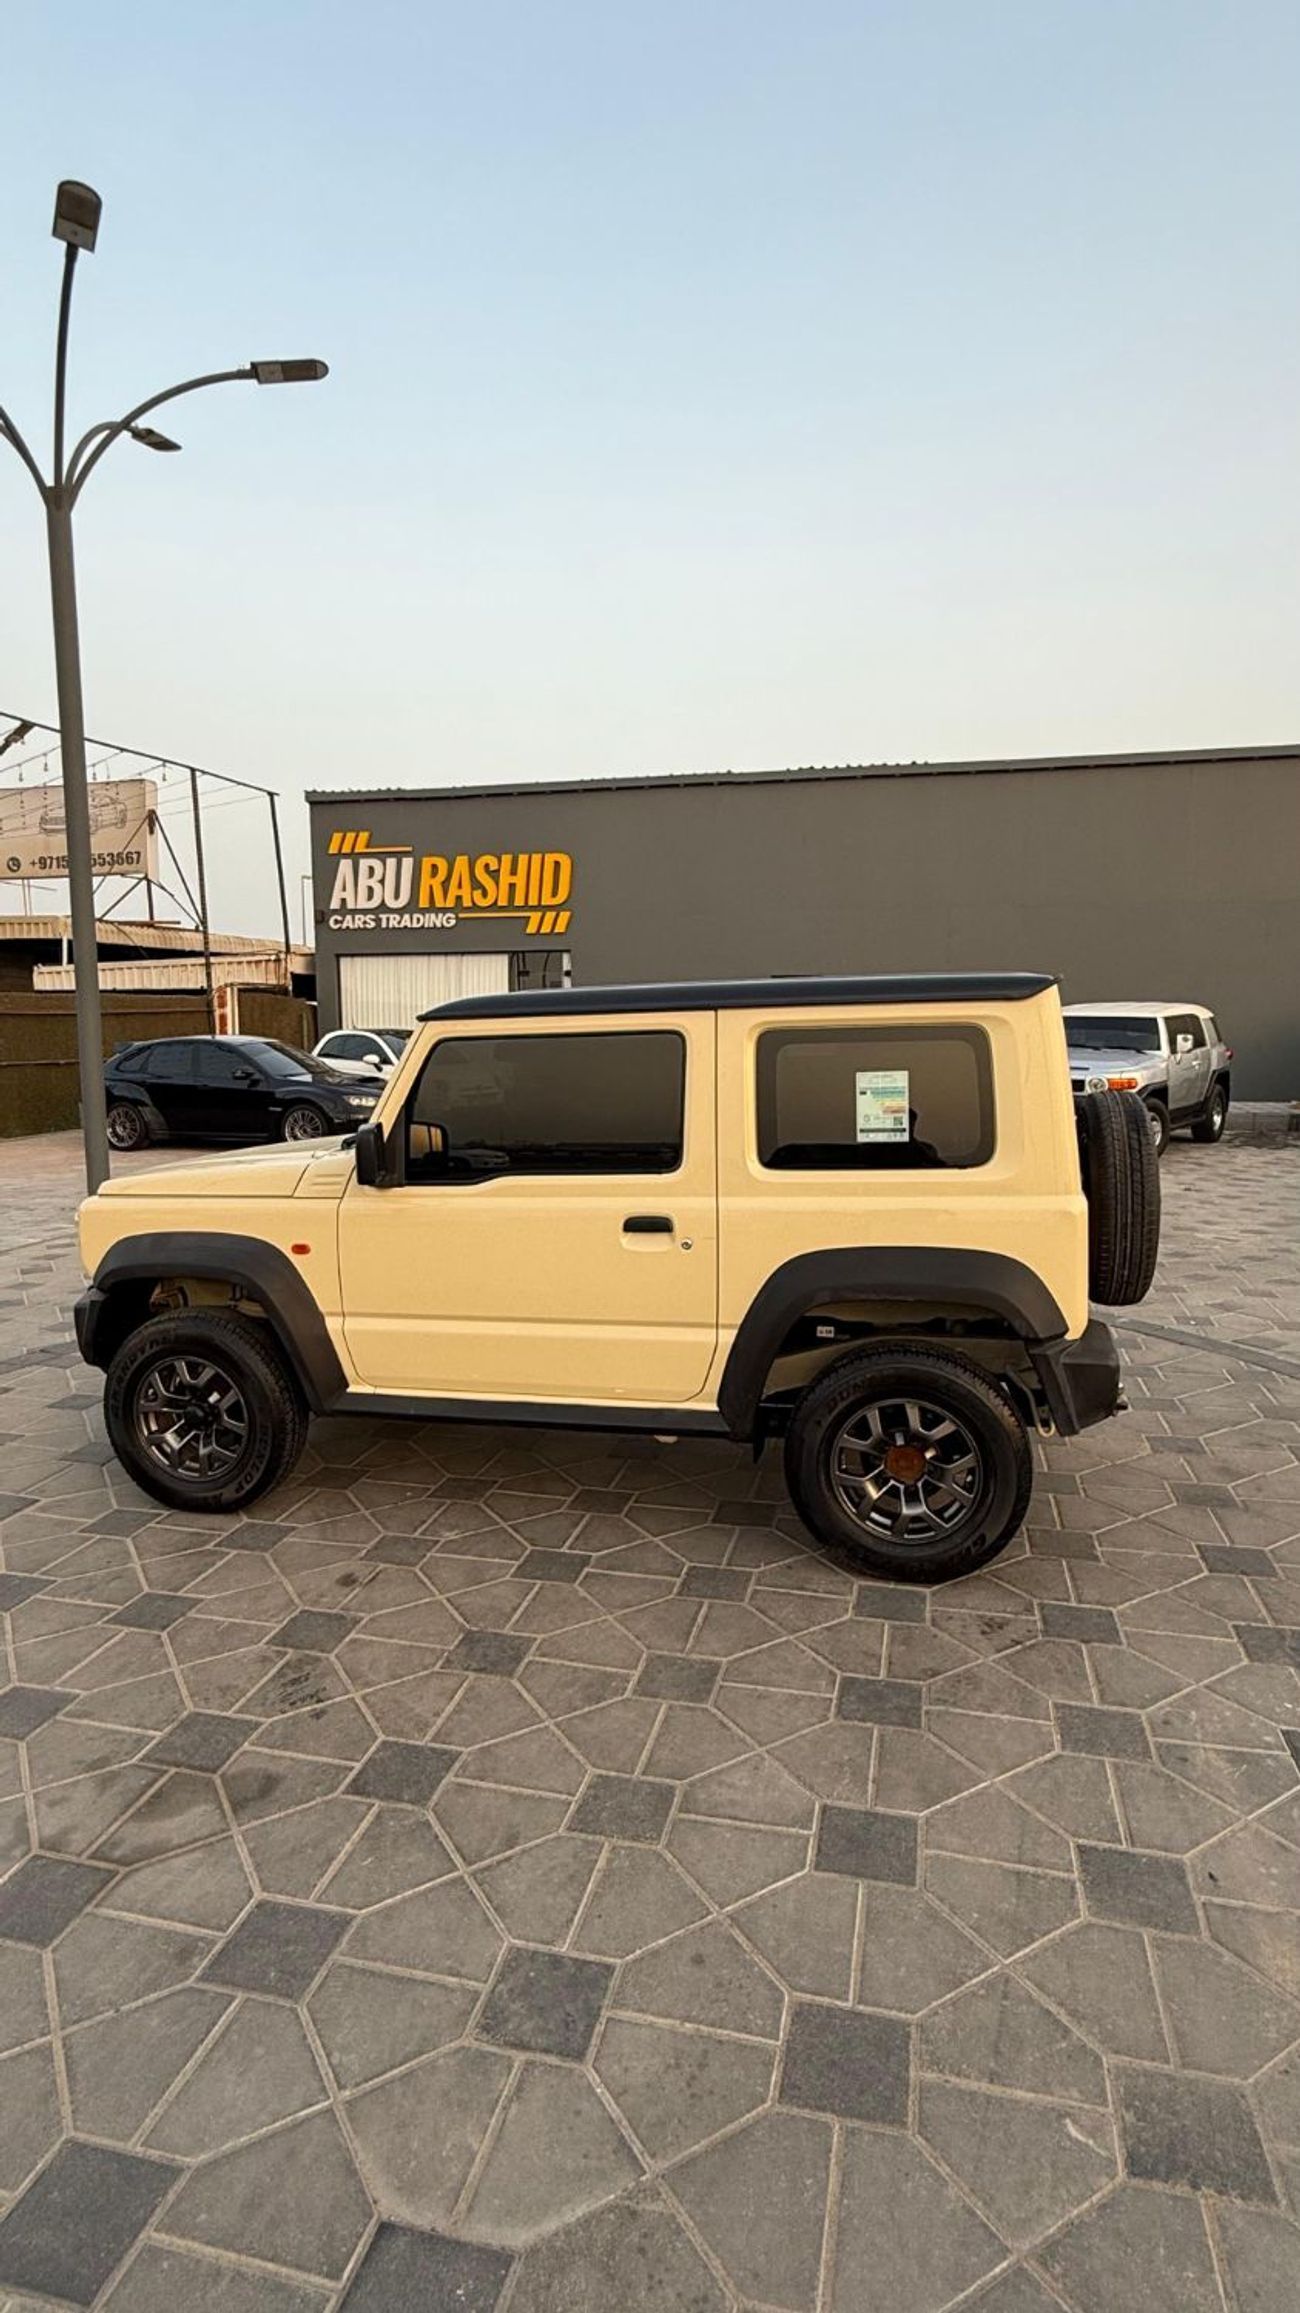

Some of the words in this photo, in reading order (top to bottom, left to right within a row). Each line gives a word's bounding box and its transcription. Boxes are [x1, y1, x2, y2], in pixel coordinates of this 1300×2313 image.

[29, 851, 141, 870] +9715553667
[329, 857, 414, 910] ABU
[418, 852, 572, 909] RASHID
[328, 913, 376, 930] CARS
[379, 912, 457, 929] TRADING
